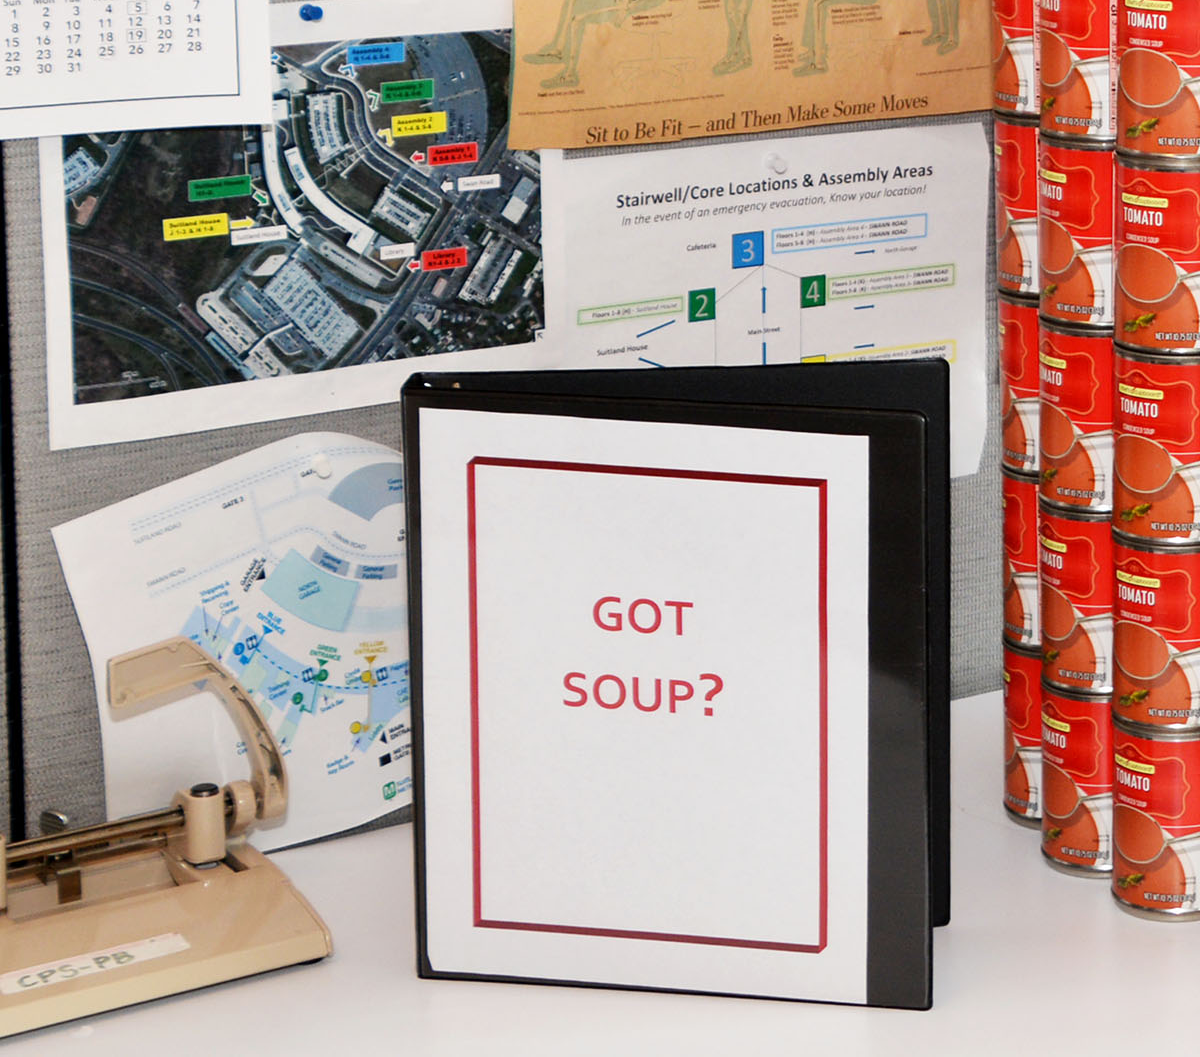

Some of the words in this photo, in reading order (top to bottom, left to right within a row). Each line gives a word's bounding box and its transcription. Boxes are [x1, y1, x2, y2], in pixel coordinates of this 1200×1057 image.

[11, 23, 19, 34] 8
[42, 21, 50, 30] 9
[66, 20, 81, 30] 10
[99, 18, 111, 28] 11
[128, 16, 143, 27] 12
[157, 15, 172, 25] 13
[187, 14, 201, 23] 14
[1127, 11, 1167, 30] TOMATO
[5, 37, 20, 48] 15
[36, 35, 51, 46] 16
[67, 34, 81, 44] 17
[99, 32, 114, 42] 18
[129, 29, 144, 41] 19
[157, 29, 173, 40] 20
[187, 27, 200, 38] 21
[5, 51, 21, 62] 22
[36, 49, 52, 60] 23
[67, 48, 82, 59] 24
[99, 45, 115, 57] 25
[128, 44, 144, 55] 26
[158, 43, 173, 53] 27
[187, 41, 202, 52] 28
[5, 65, 21, 76] 29
[37, 63, 53, 74] 30
[67, 62, 81, 73] 31
[585, 125, 608, 145] Sit
[613, 126, 629, 141] to
[633, 121, 657, 140] Be
[661, 118, 683, 137] Fit
[705, 113, 736, 132] and
[741, 109, 781, 130] Then
[785, 105, 829, 124] Make
[833, 99, 876, 117] Some
[880, 93, 929, 112] Moves
[616, 185, 725, 209] Stairwell/Core
[729, 177, 798, 196] Locations
[802, 173, 814, 188] &
[818, 167, 889, 186] Assembly
[892, 165, 933, 179] Areas
[621, 215, 632, 227] In
[634, 213, 651, 225] the
[653, 210, 682, 223] event
[684, 208, 696, 221] of
[697, 208, 710, 218] an
[712, 201, 767, 216] emergency
[769, 196, 827, 209] evacuation,
[829, 192, 857, 203] Know
[859, 190, 881, 202] your
[883, 184, 927, 198] location!
[1123, 206, 1163, 227] TOMATO
[686, 242, 717, 252] Cafeteria
[741, 239, 755, 263] 3
[805, 280, 821, 303] 4
[695, 294, 709, 318] 2
[747, 328, 761, 336] Main
[596, 347, 626, 357] Suitland
[627, 343, 648, 353] House
[1120, 397, 1159, 418] TOMATO
[1117, 584, 1156, 606] TOMATO
[592, 596, 694, 636] GOT
[562, 672, 724, 717] SOUP?
[1115, 768, 1150, 792] TOMATO
[17, 950, 135, 989] CPS-PB
